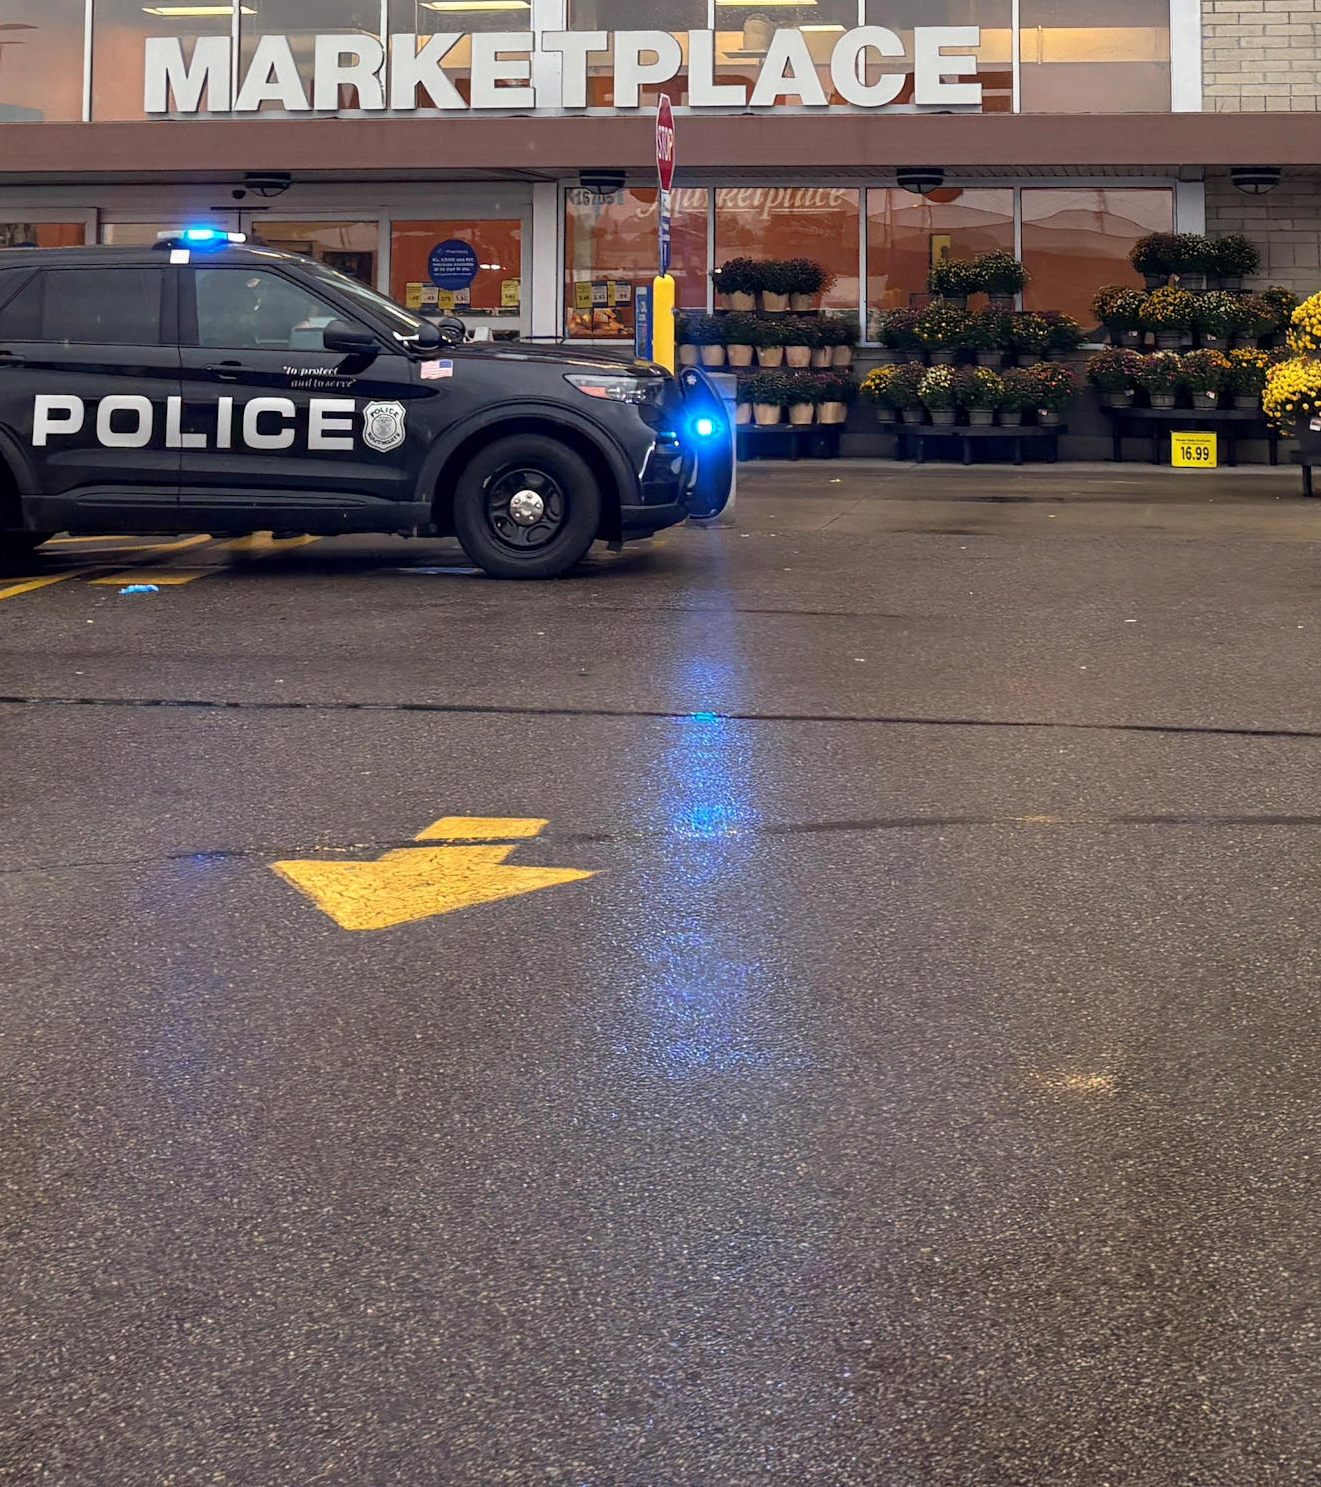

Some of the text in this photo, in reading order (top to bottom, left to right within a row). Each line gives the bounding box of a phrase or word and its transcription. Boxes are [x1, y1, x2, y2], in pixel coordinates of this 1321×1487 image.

[144, 24, 983, 113] MARKETPLACE
[658, 125, 673, 162] STOP
[32, 395, 356, 451] POLICE
[370, 407, 399, 418] POLICE
[1181, 446, 1210, 461] 16.99
